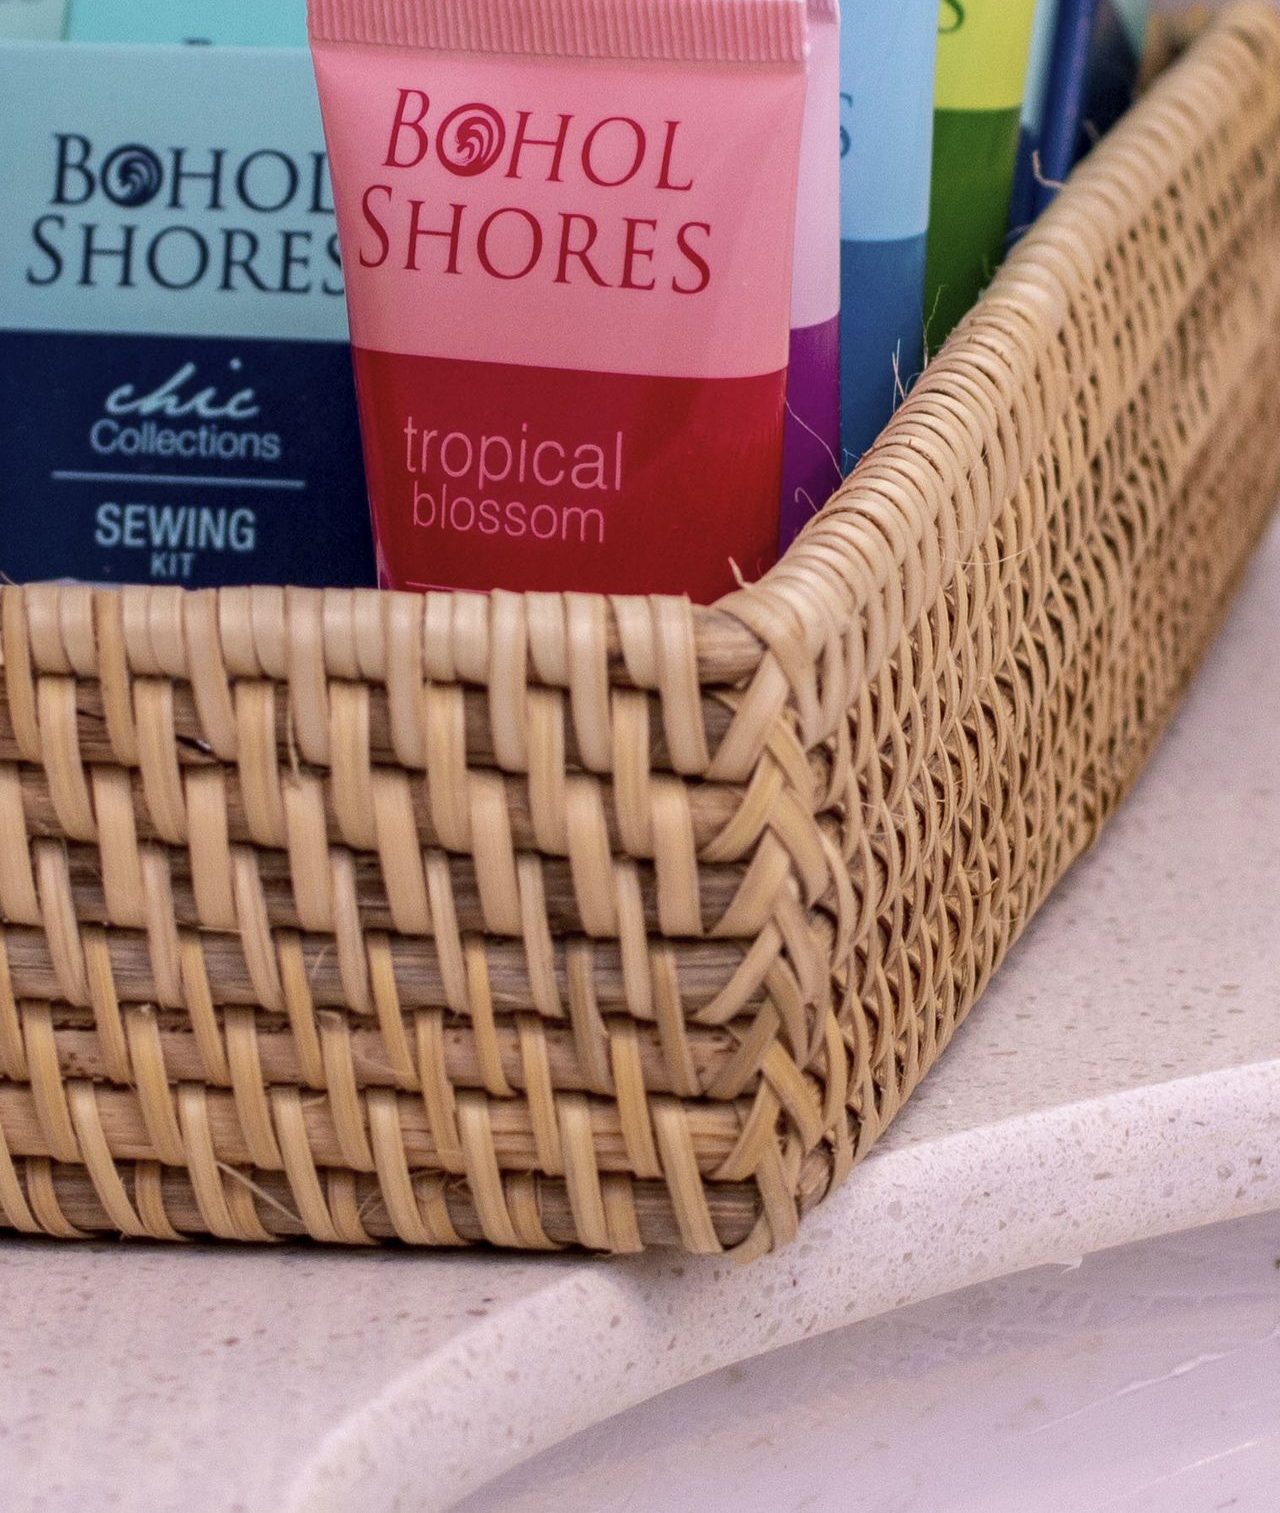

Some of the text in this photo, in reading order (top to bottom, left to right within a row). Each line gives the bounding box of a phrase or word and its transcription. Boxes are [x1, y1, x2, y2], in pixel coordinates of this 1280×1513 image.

[382, 88, 693, 191] BOHOL
[359, 184, 711, 294] SHORES
[105, 358, 260, 419] chic
[89, 418, 281, 461] Collections
[404, 416, 622, 490] tropical
[95, 502, 257, 551] SEWING
[414, 480, 604, 542] blossom
[150, 551, 195, 577] KIT
